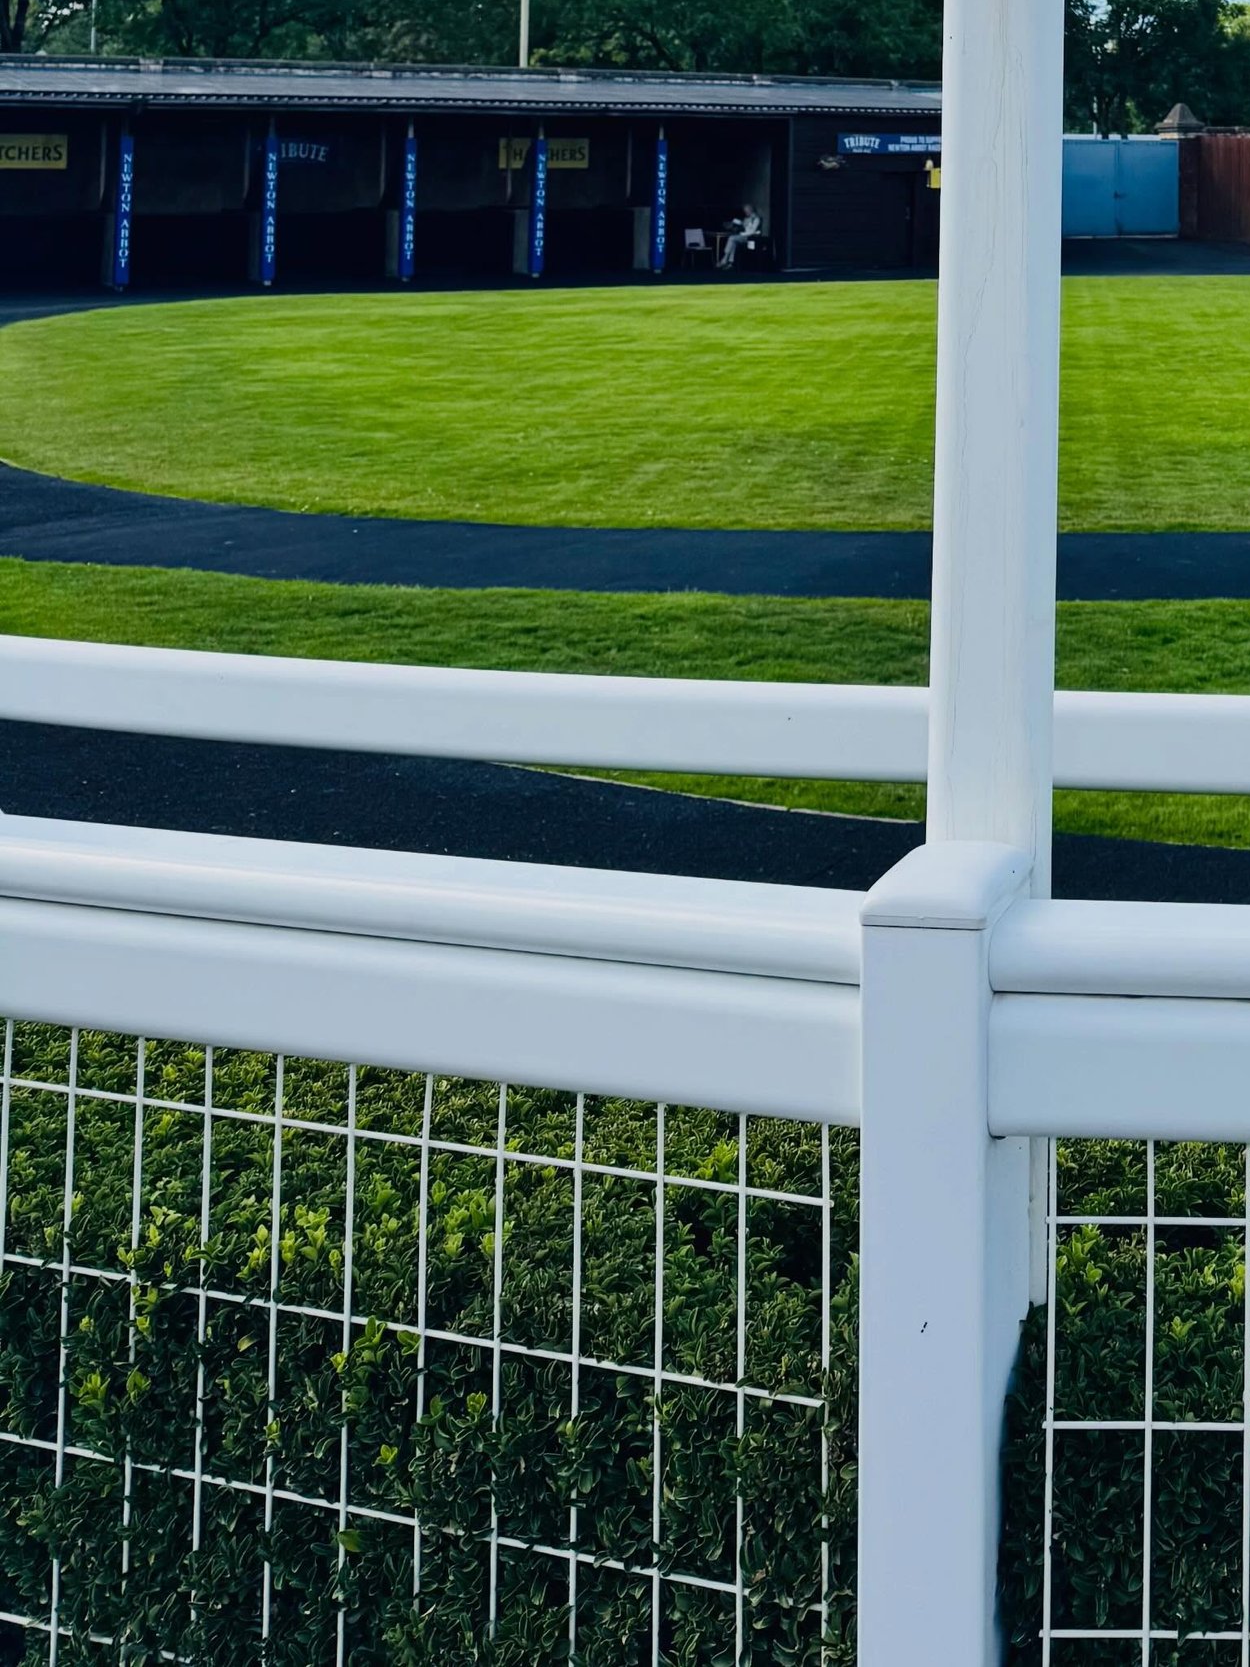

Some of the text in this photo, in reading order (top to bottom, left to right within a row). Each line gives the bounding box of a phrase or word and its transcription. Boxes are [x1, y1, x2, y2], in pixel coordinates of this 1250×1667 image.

[843, 135, 881, 149] TRIBUTE
[121, 153, 133, 212] NEWTON
[267, 153, 277, 209] NEWTON
[405, 154, 416, 208] NEWTON
[536, 154, 547, 207] NEWTON
[657, 154, 667, 205] NEWTON
